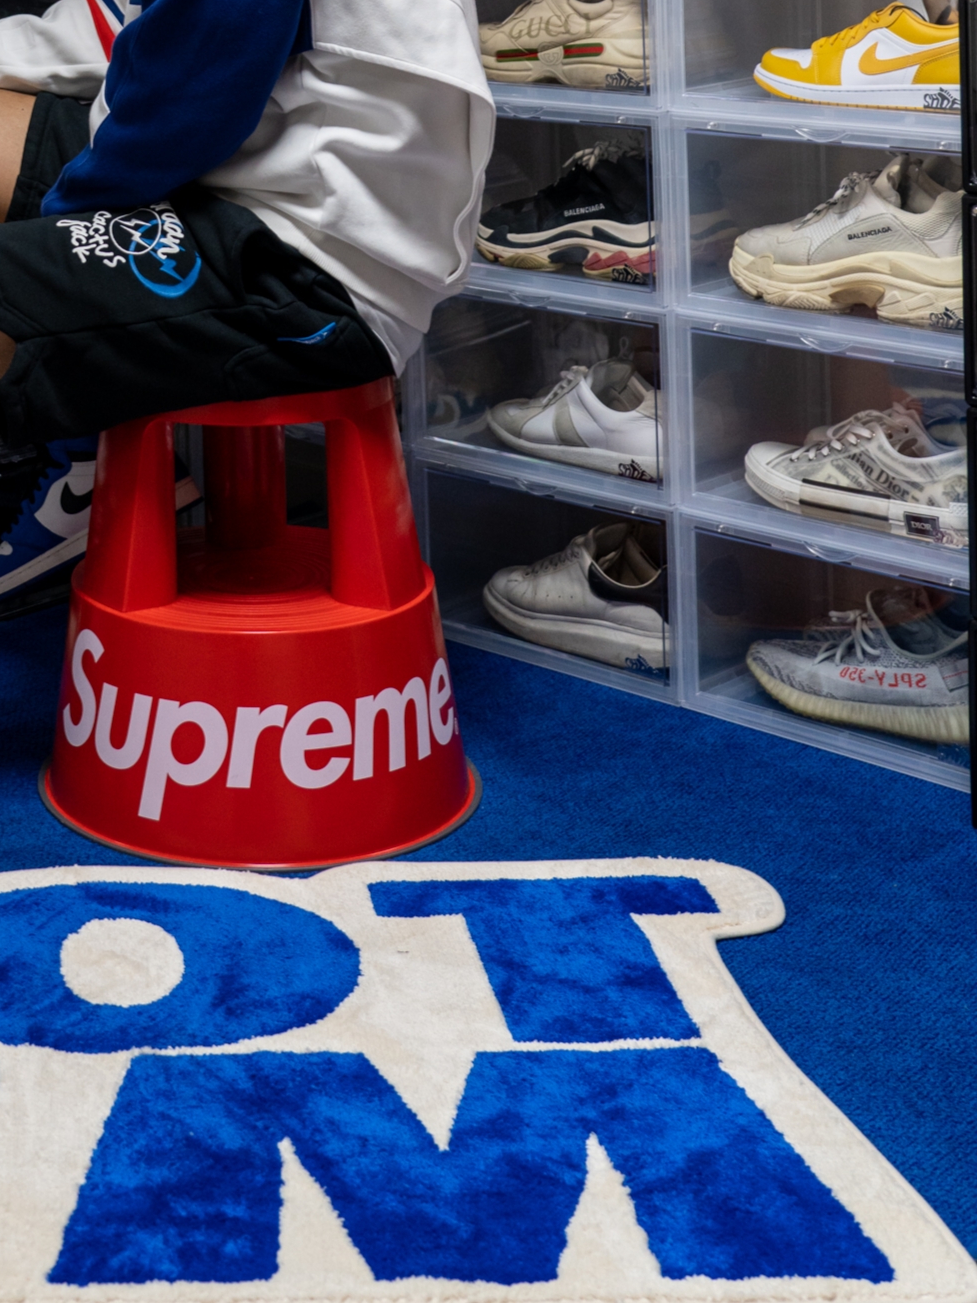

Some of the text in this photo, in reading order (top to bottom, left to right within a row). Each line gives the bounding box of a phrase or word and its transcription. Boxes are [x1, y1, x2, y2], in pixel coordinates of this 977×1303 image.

[509, 12, 592, 40] GUCCI
[564, 203, 605, 217] BALENCIAGA
[847, 226, 892, 240] BALENCIAGA
[875, 470, 910, 499] Dior
[911, 520, 932, 531] DIOR
[63, 628, 454, 821] Supreme
